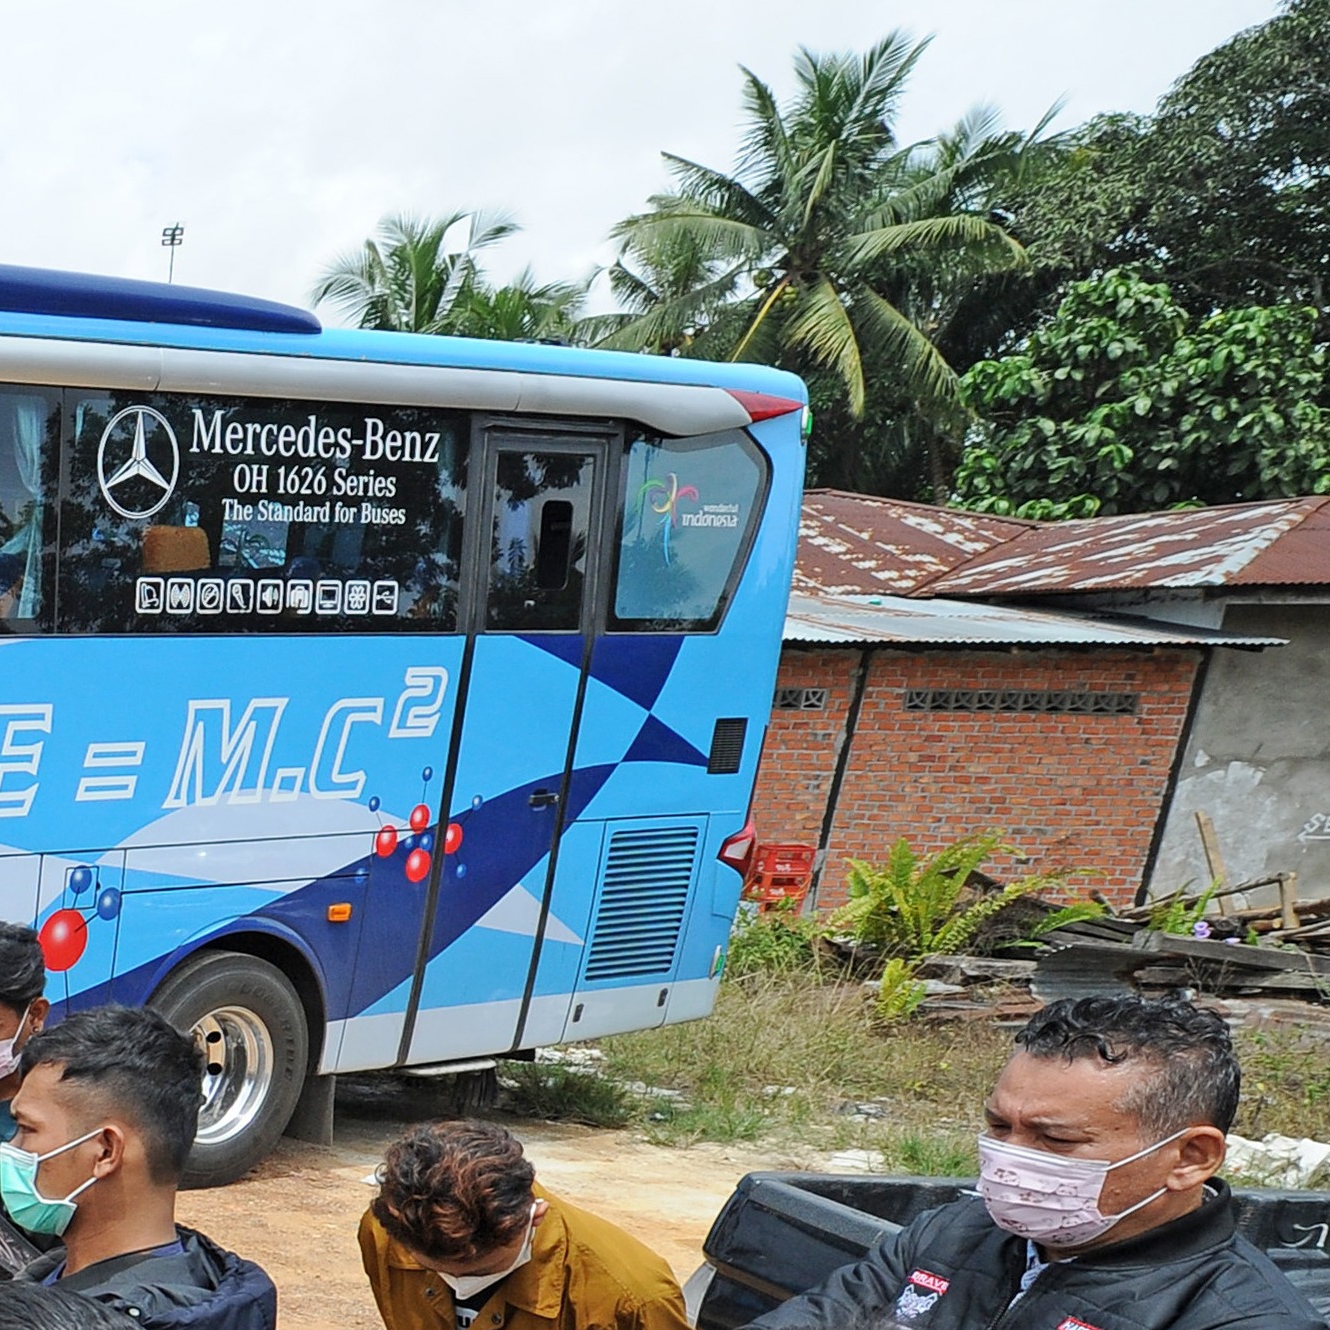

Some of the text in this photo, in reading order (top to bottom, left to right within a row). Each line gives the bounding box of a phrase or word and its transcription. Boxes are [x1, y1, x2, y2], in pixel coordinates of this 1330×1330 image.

[190, 408, 440, 463] Mercedes-Benz
[233, 463, 397, 498] OH 1626 Series
[222, 498, 407, 525] The Standard for Buses
